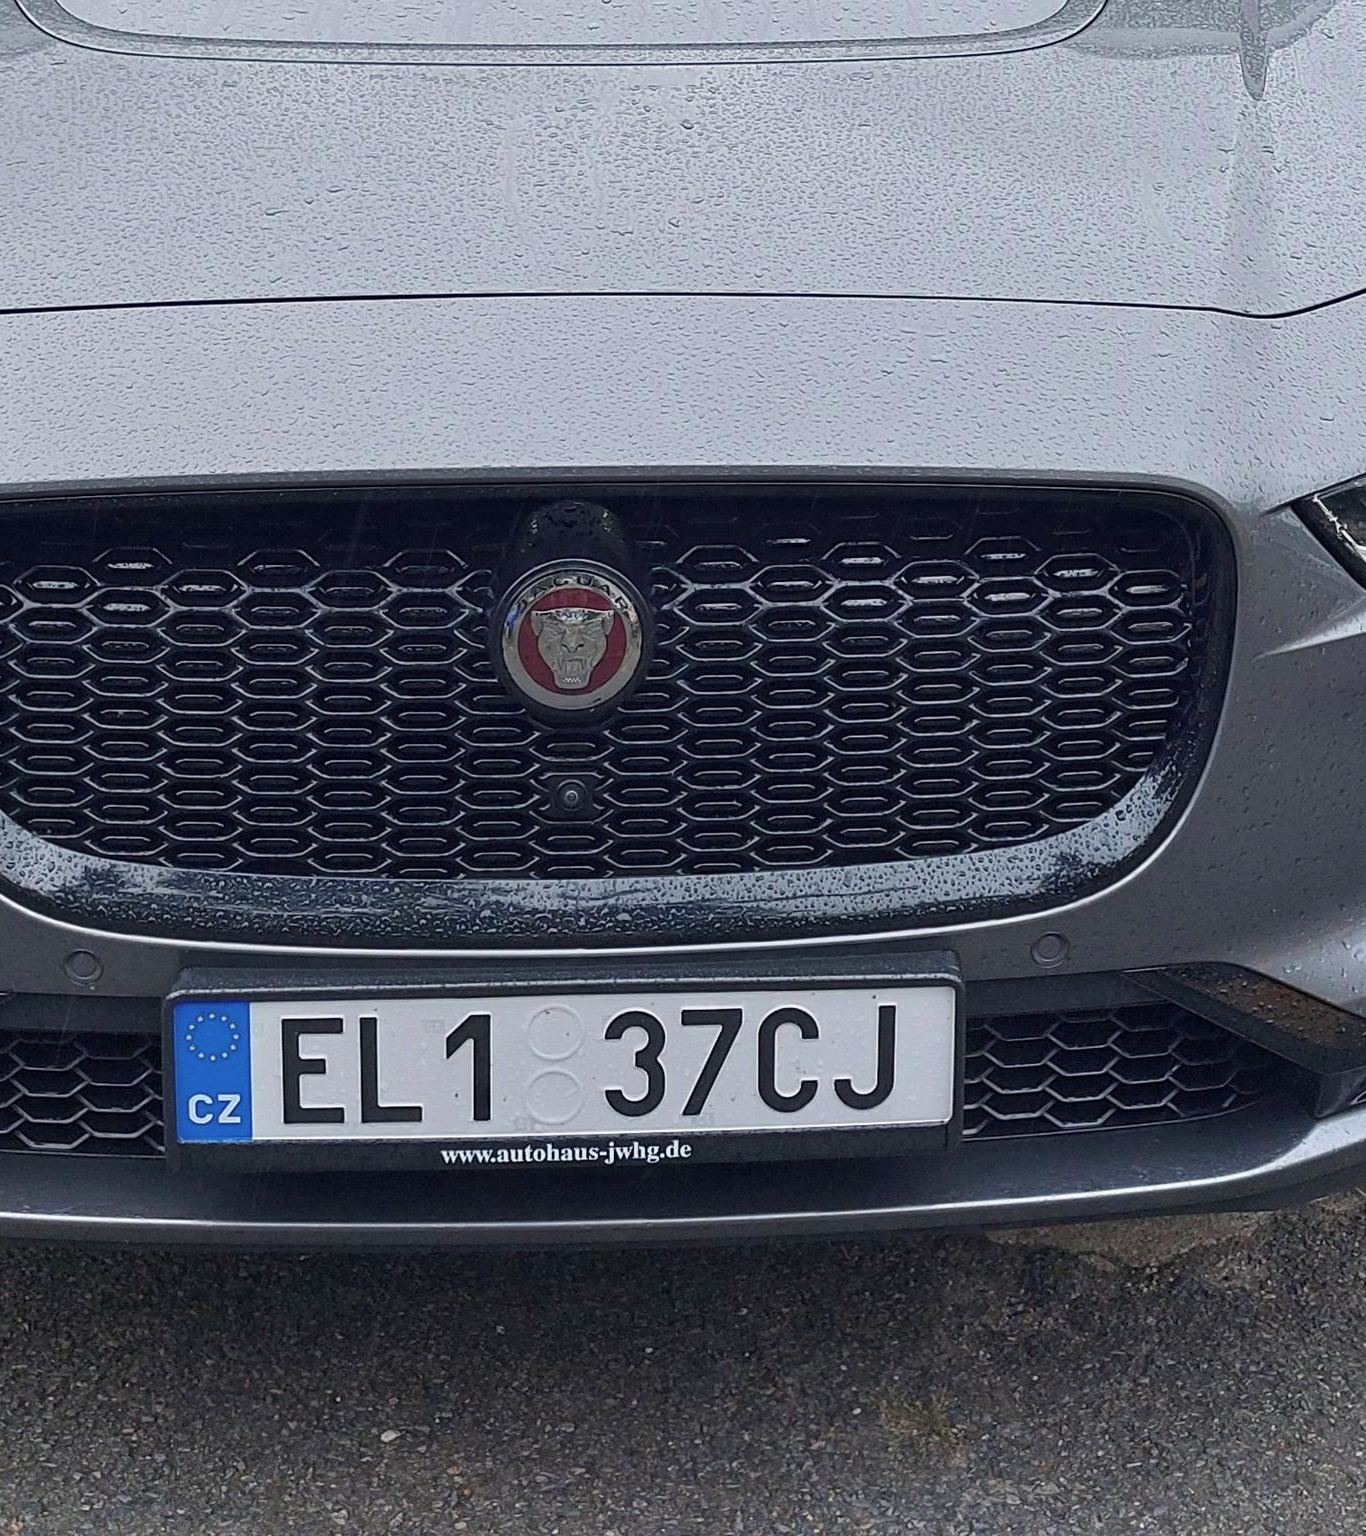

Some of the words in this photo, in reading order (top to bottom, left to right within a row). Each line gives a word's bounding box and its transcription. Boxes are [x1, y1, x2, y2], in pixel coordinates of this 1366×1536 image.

[516, 575, 630, 613] JAGUAR
[279, 1012, 492, 1125] EL1
[602, 1004, 898, 1118] 37CJ
[186, 1093, 243, 1125] CZ
[440, 1140, 693, 1165] www.autohaus-jwhg.de
